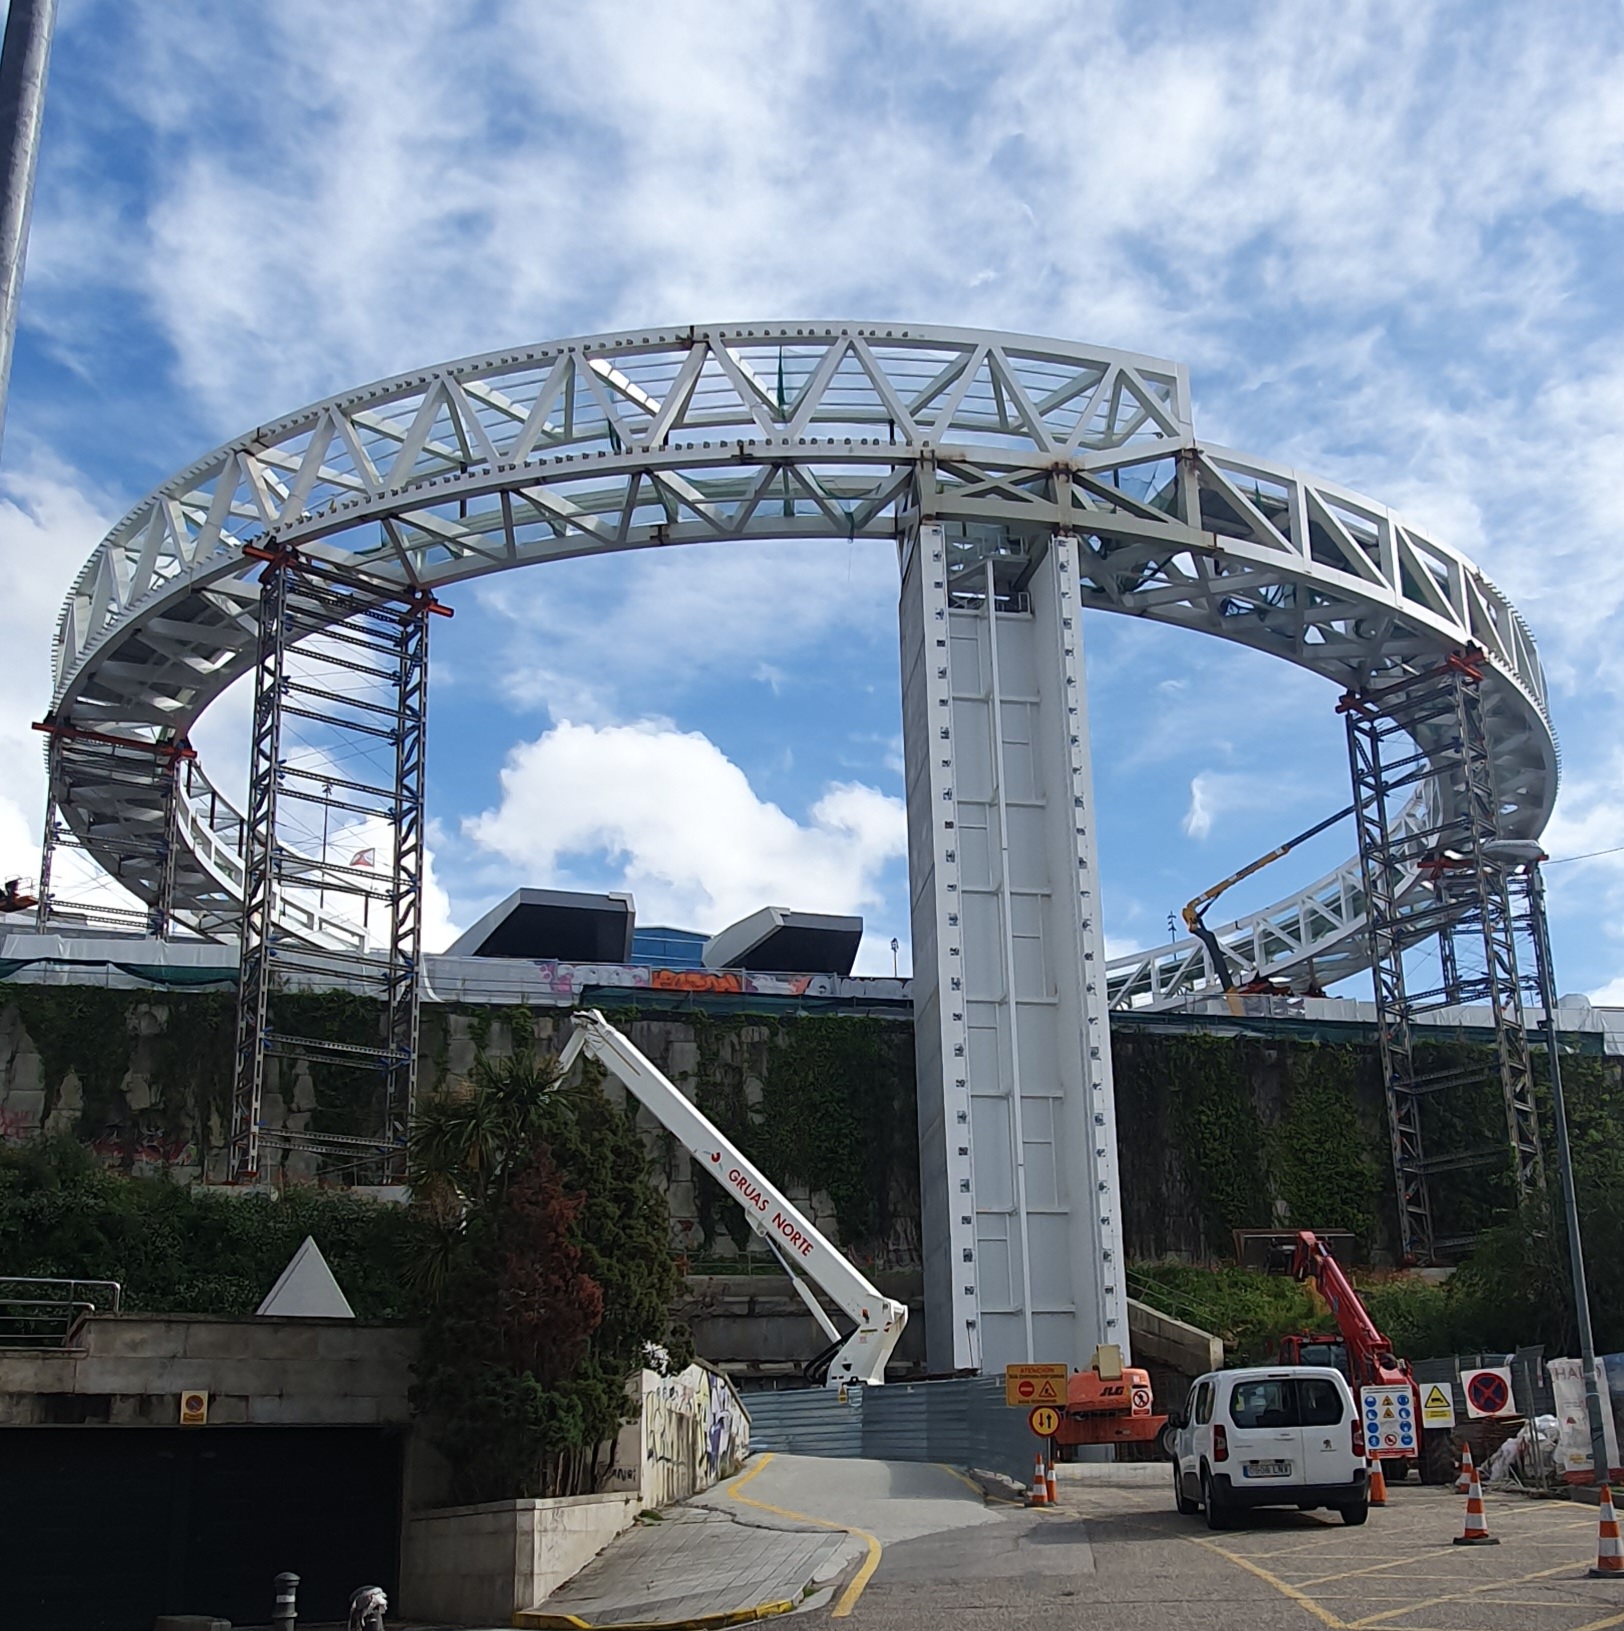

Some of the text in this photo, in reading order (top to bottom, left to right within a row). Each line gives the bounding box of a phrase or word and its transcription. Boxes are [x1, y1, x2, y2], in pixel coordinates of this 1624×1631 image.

[728, 1169, 814, 1257] GRUAS NORTE
[1099, 1385, 1125, 1397] JLG
